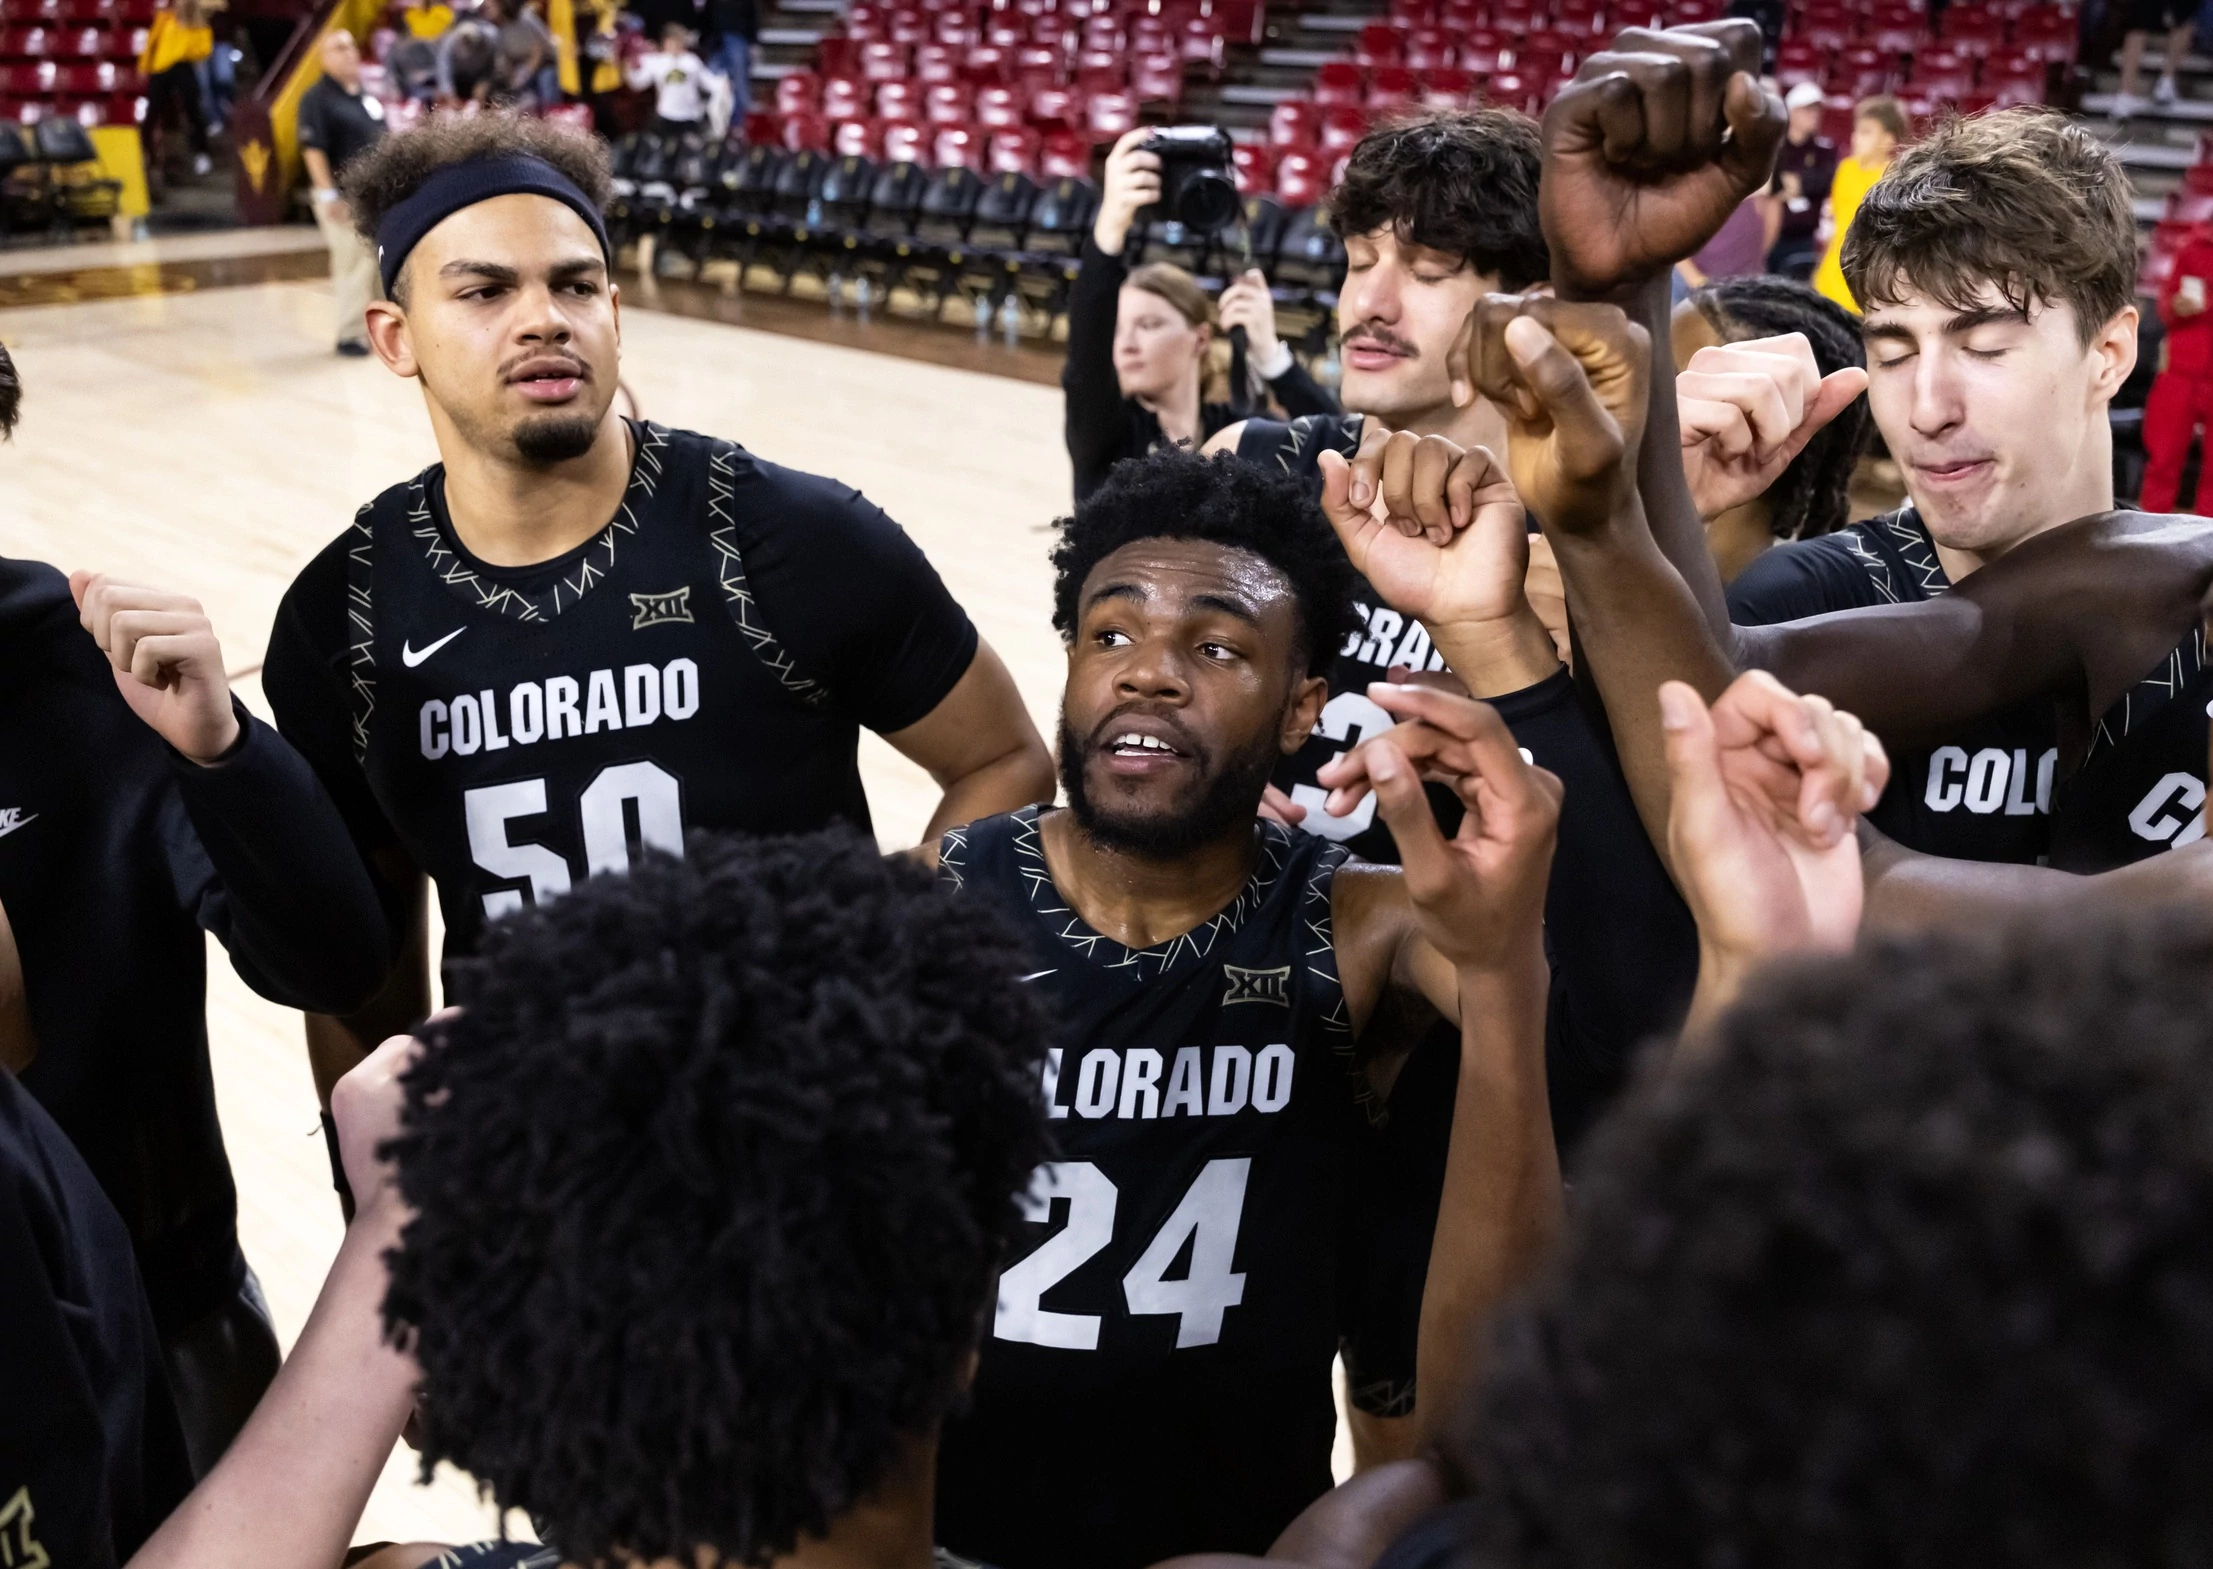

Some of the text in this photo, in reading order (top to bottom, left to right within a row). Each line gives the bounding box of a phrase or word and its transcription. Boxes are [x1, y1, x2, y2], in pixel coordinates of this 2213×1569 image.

[420, 657, 700, 761] COLORADO
[464, 760, 685, 921] 50
[992, 1156, 1252, 1351] 24
